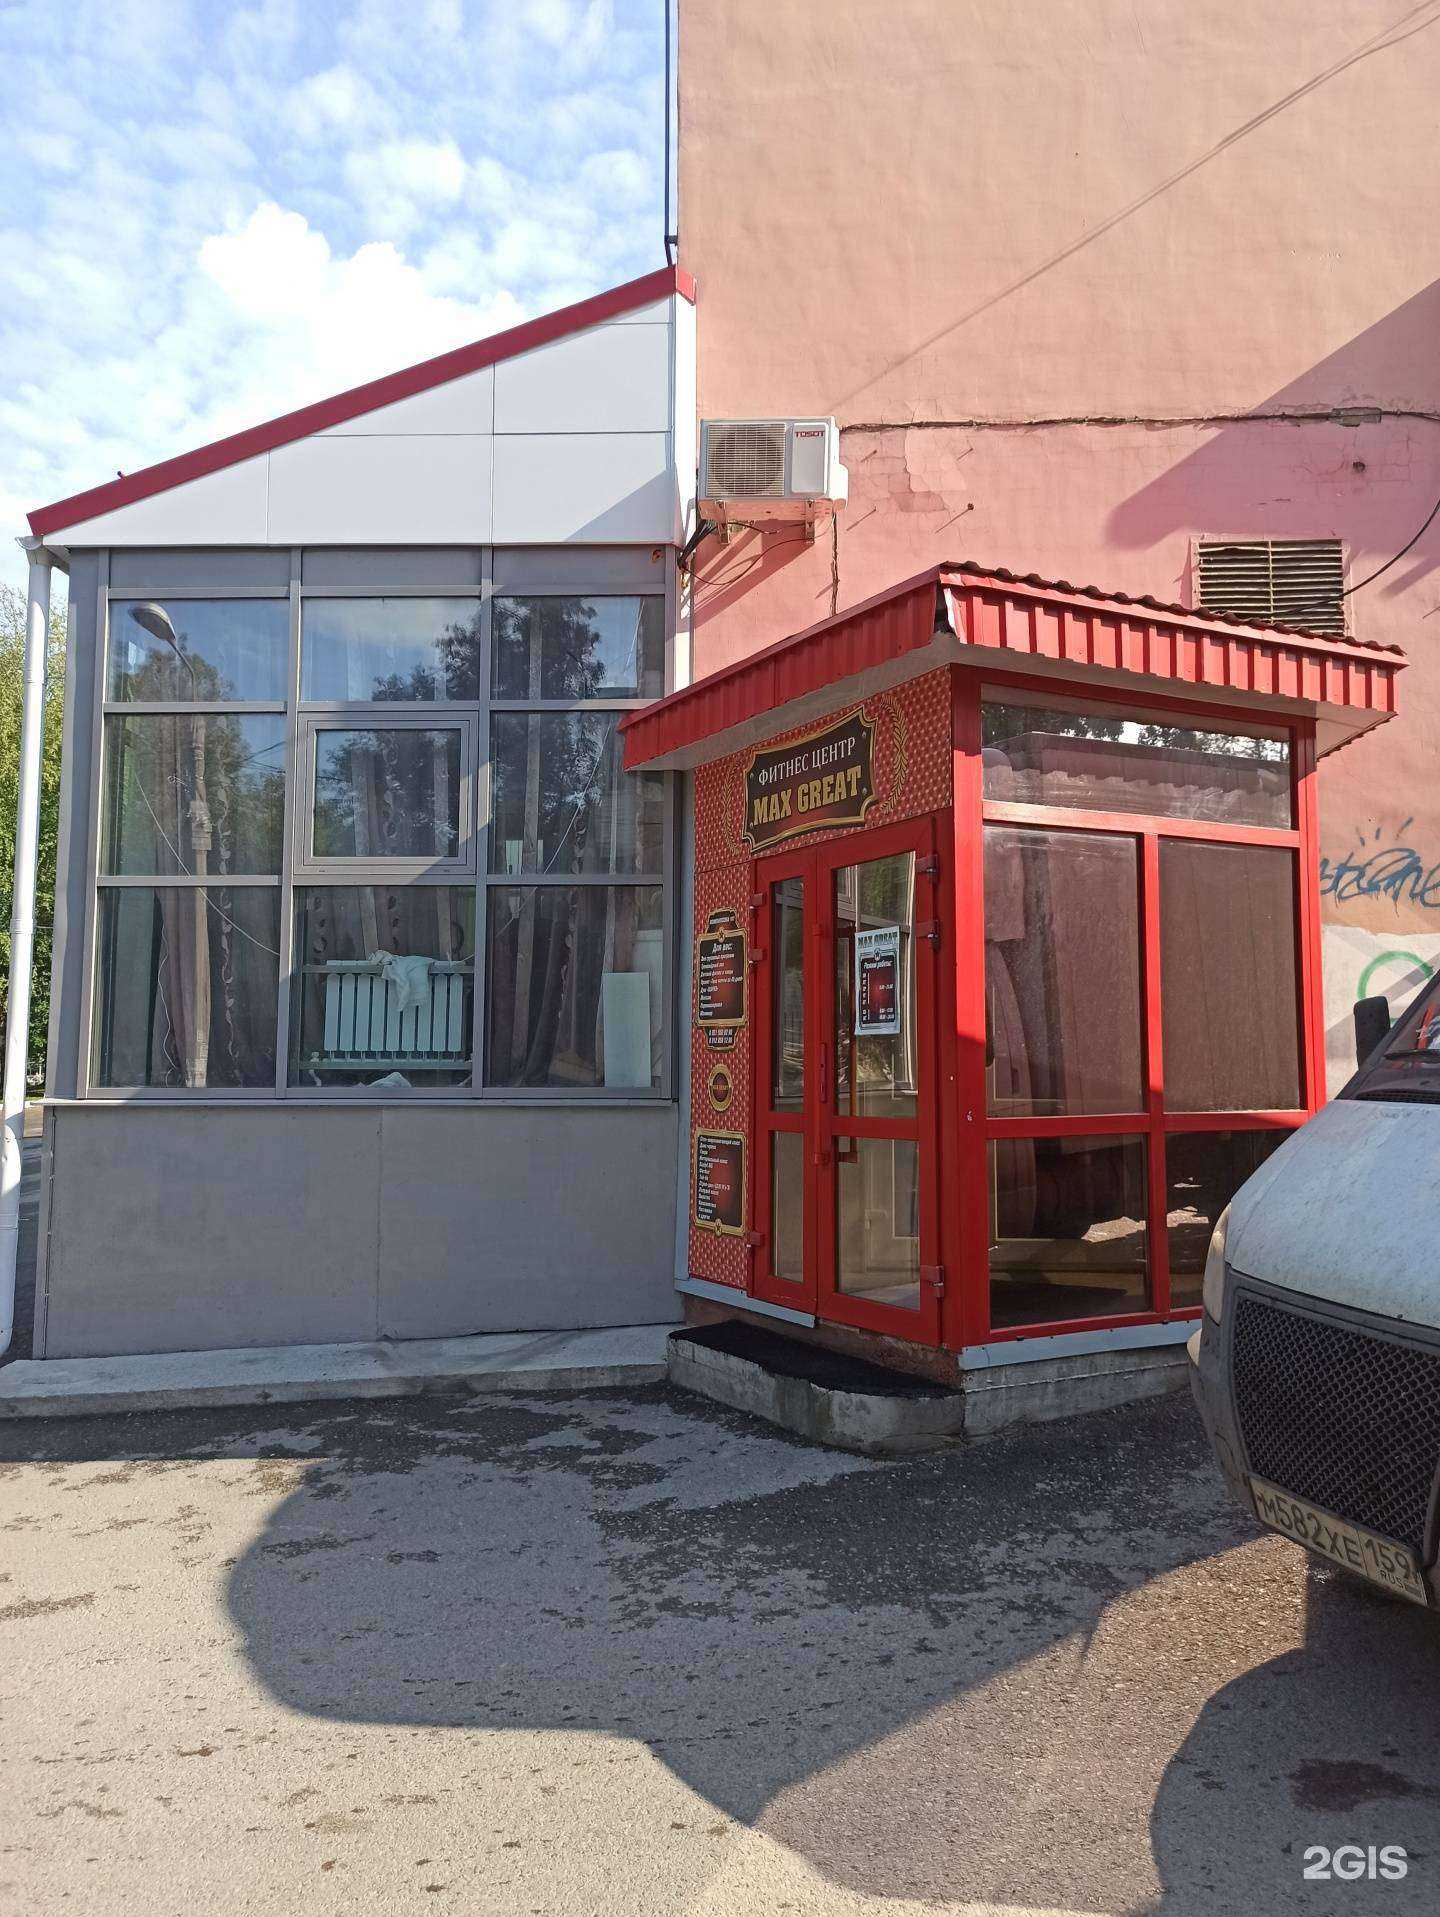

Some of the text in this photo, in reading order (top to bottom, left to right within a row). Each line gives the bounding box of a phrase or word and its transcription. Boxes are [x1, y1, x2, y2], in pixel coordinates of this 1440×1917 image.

[758, 737, 856, 786] ФИТНЕС ЦЕНТР
[753, 765, 862, 826] MAX GREAT
